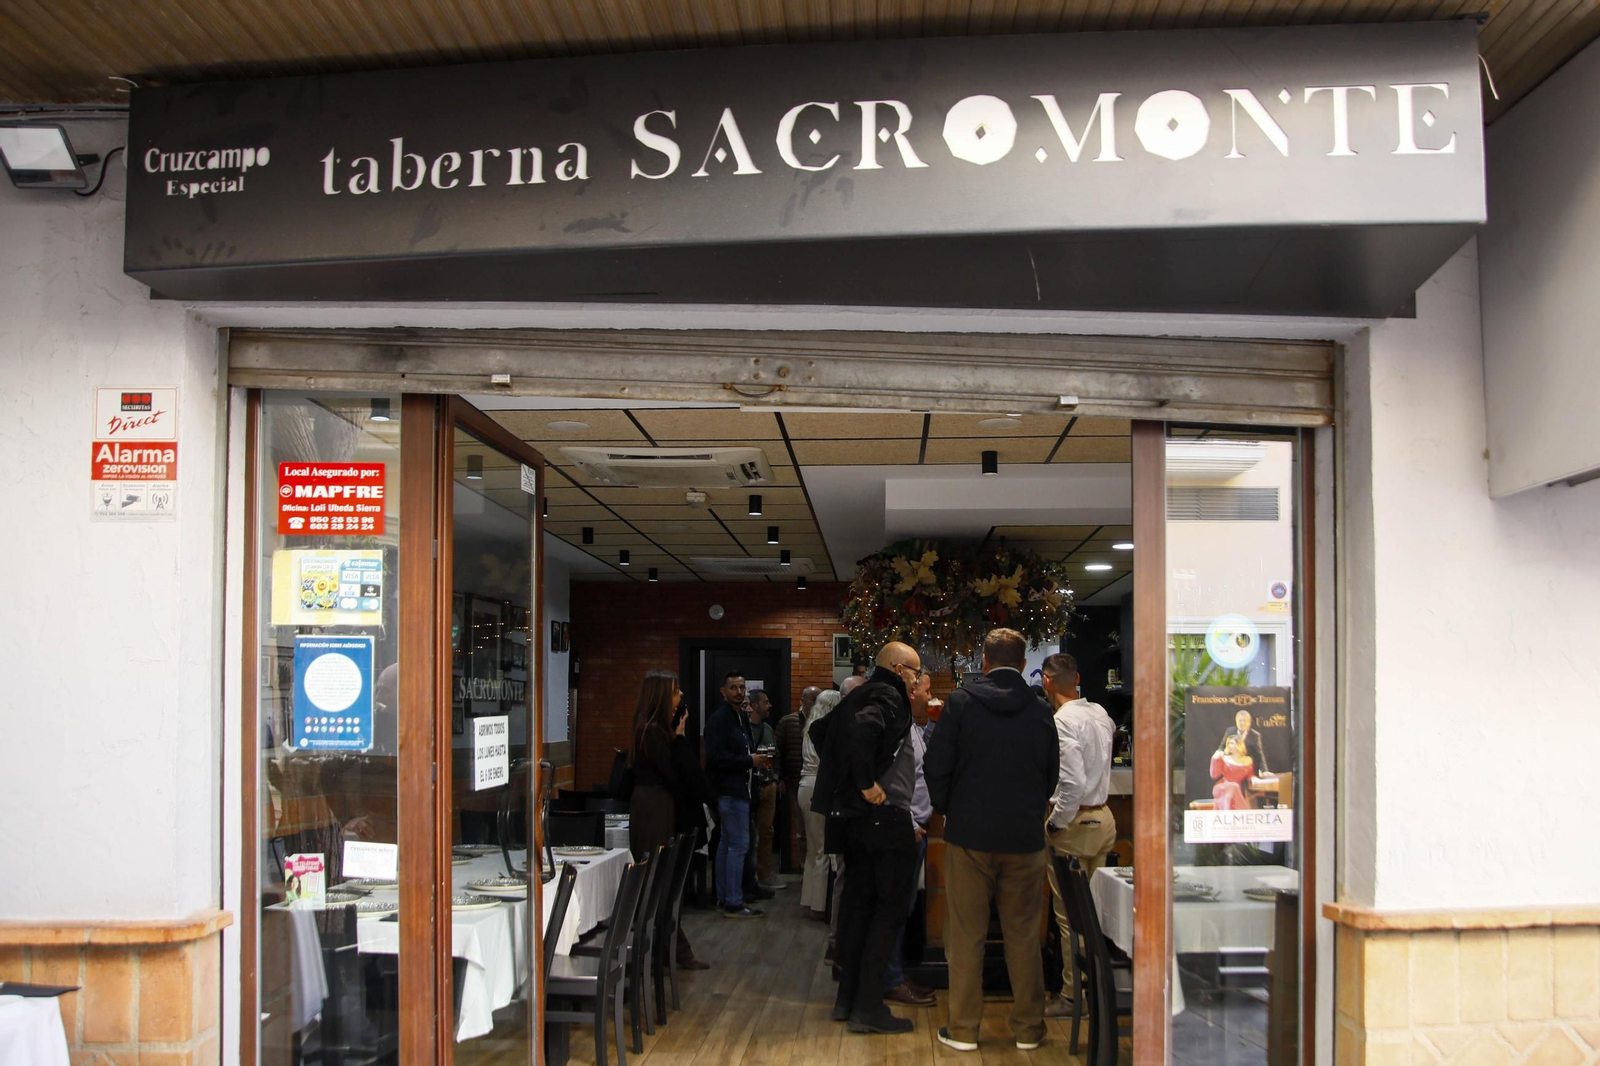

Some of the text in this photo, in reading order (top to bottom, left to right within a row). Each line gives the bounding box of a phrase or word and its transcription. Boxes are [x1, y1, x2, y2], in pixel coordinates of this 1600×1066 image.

[320, 82, 1456, 196] taberna SACROMONTE
[144, 146, 270, 173] Cruzcampo
[166, 176, 245, 199] Especial
[107, 410, 168, 436] Direct
[95, 443, 175, 463] Alarma
[102, 464, 167, 474] zerovision
[285, 466, 380, 479] Local Asegurado por:
[294, 485, 384, 498] MAPFRE
[282, 504, 381, 512] Oficina: Loli Ubeda Sierra
[351, 560, 379, 568] cajamar
[344, 572, 359, 580] VISA
[365, 573, 380, 581] VISA
[460, 677, 524, 701] SACROMONTE
[1192, 695, 1228, 704] Francisco
[478, 722, 505, 736] ABRIMOS TODOS
[484, 745, 494, 758] LUNES
[495, 743, 506, 757] HASTA
[480, 769, 485, 783] EL
[488, 767, 493, 781] DE
[493, 766, 504, 780] ENERO
[1192, 812, 1283, 830] 08 ALMERÍA
